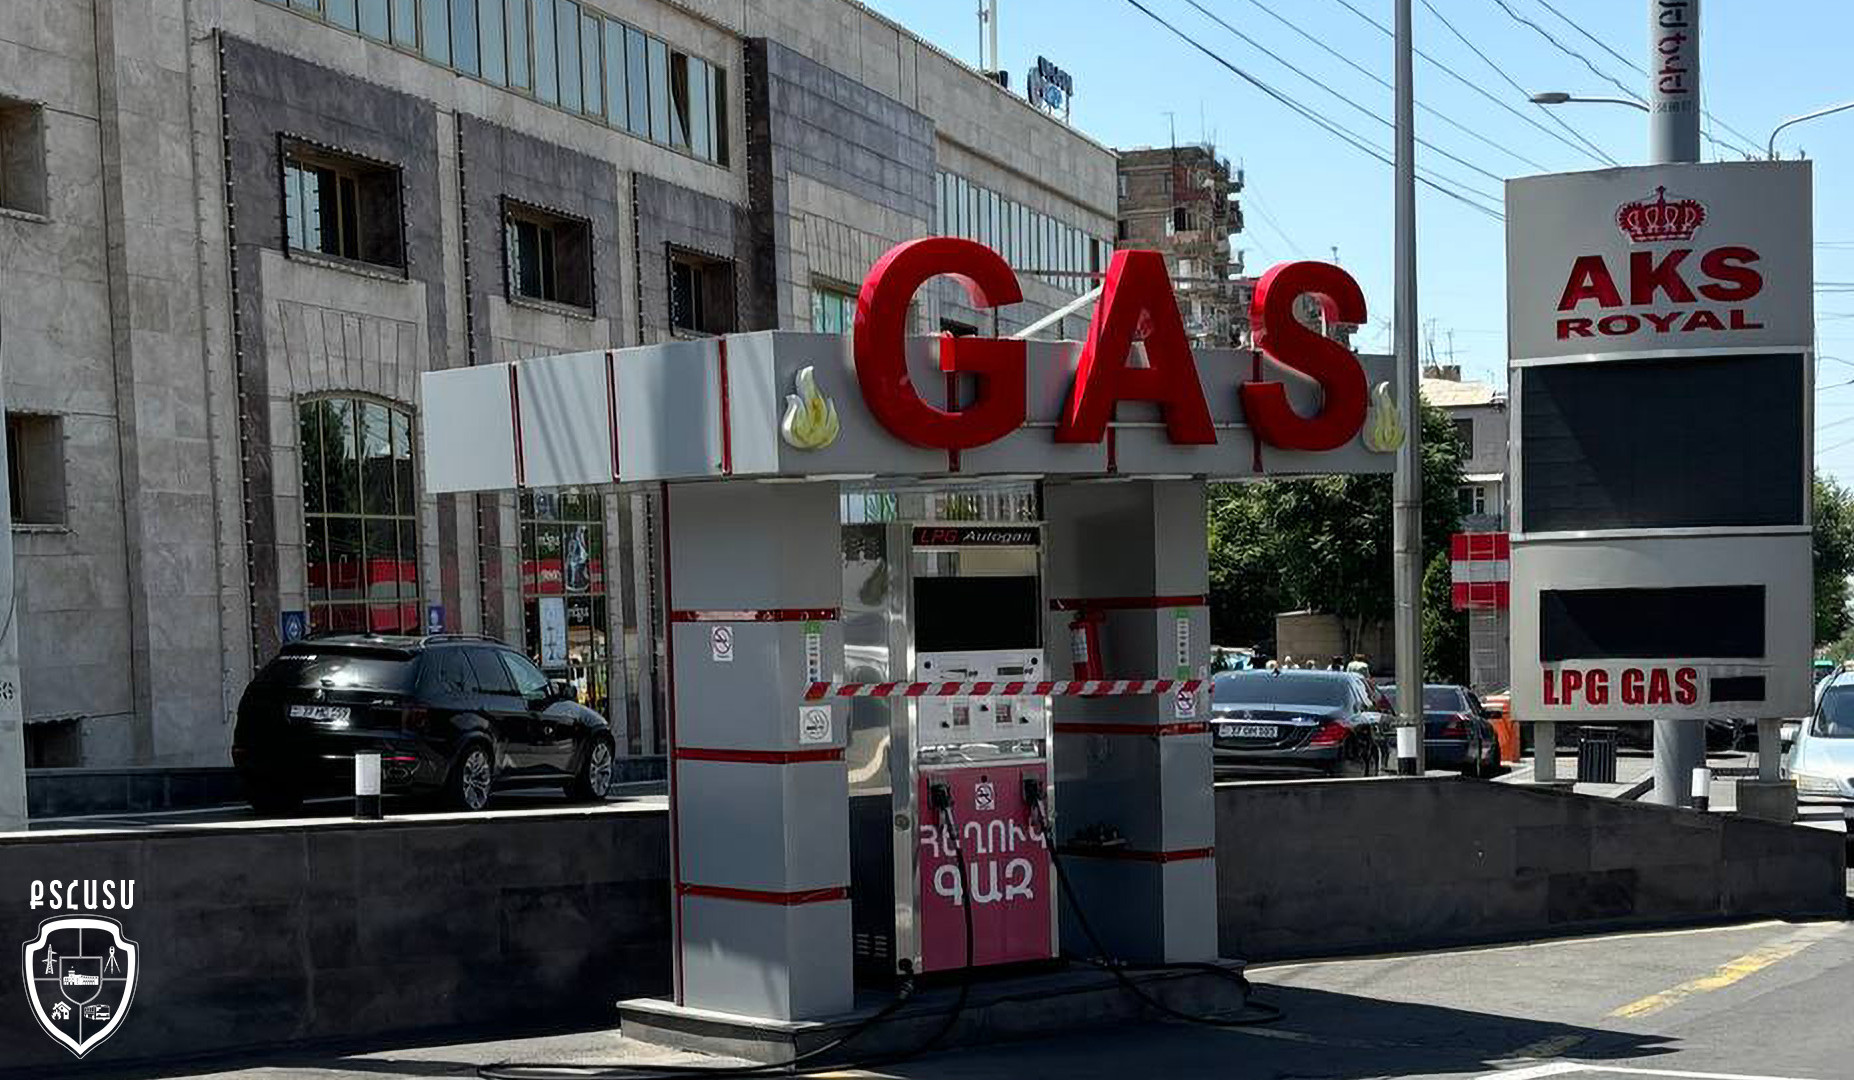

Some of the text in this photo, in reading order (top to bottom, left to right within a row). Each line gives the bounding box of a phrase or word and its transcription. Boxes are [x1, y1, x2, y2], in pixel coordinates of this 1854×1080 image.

[1557, 246, 1763, 311] AKS
[853, 237, 1367, 452] GAS
[1557, 309, 1764, 341] ROYAL
[921, 529, 958, 543] LPG
[1543, 667, 1697, 706] LPG GAS
[933, 858, 1034, 906] ԳԱԶ
